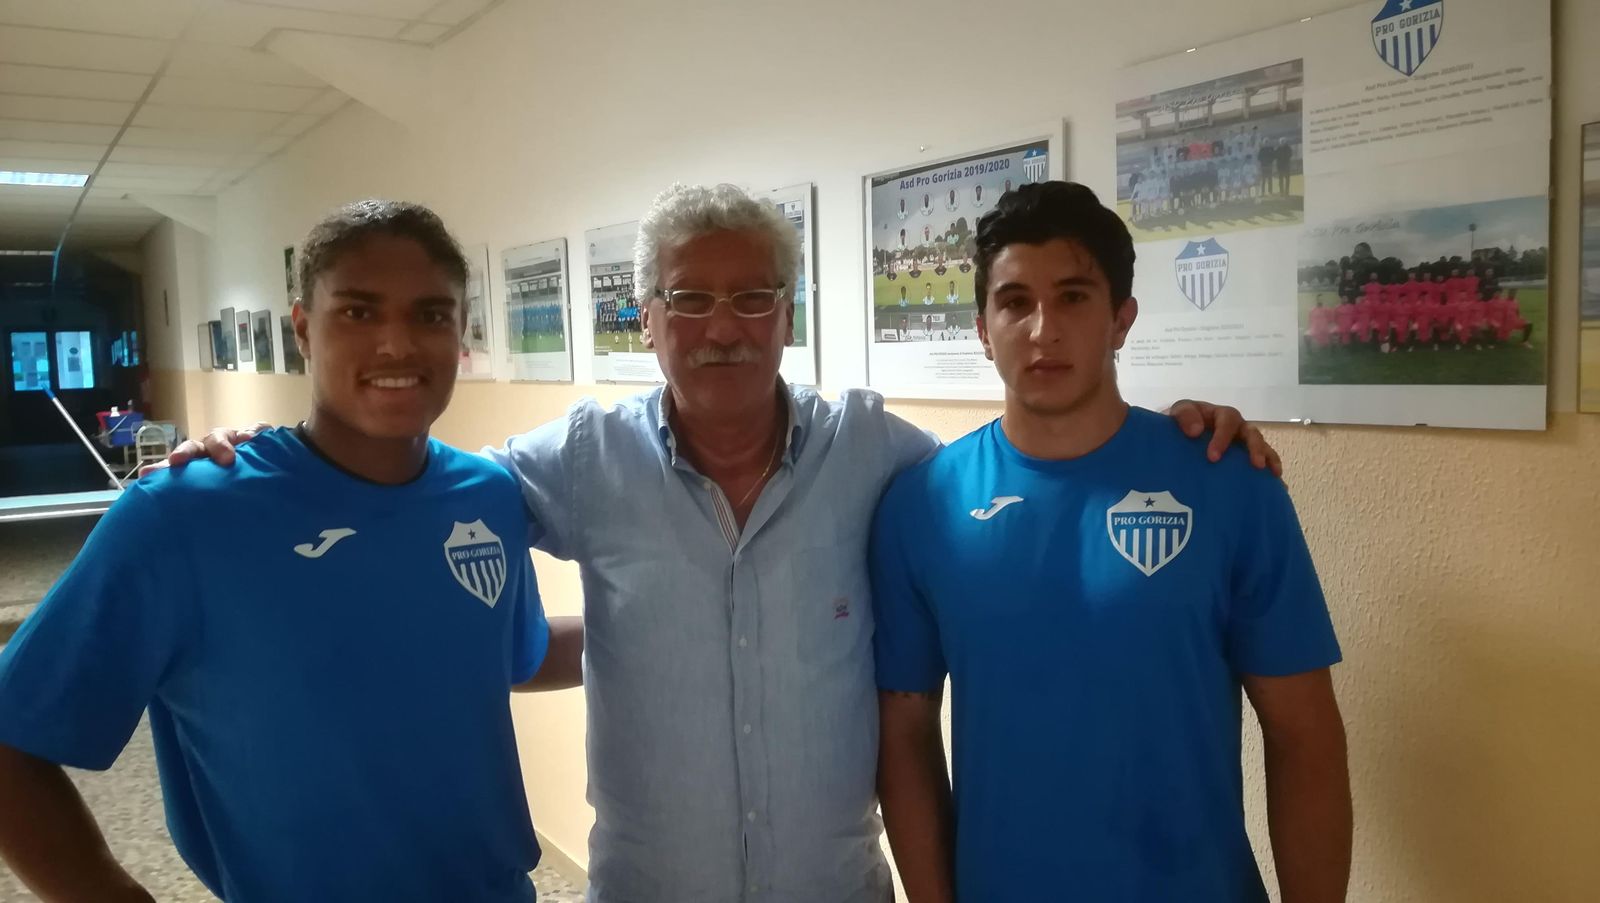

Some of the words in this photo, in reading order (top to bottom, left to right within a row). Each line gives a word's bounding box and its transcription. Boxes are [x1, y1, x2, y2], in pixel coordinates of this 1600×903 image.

[1375, 22, 1395, 37] PRO
[1399, 8, 1441, 29] GORIZIA
[899, 176, 915, 191] Asd
[916, 173, 930, 187] Pro
[932, 168, 962, 184] Gorizia
[964, 158, 1010, 178] 2019/2020
[1178, 262, 1193, 272] PRO
[1196, 258, 1227, 270] GORIZIA
[1114, 516, 1136, 526] PRO
[1138, 515, 1185, 526] GORIZIA
[452, 550, 470, 560] PRO
